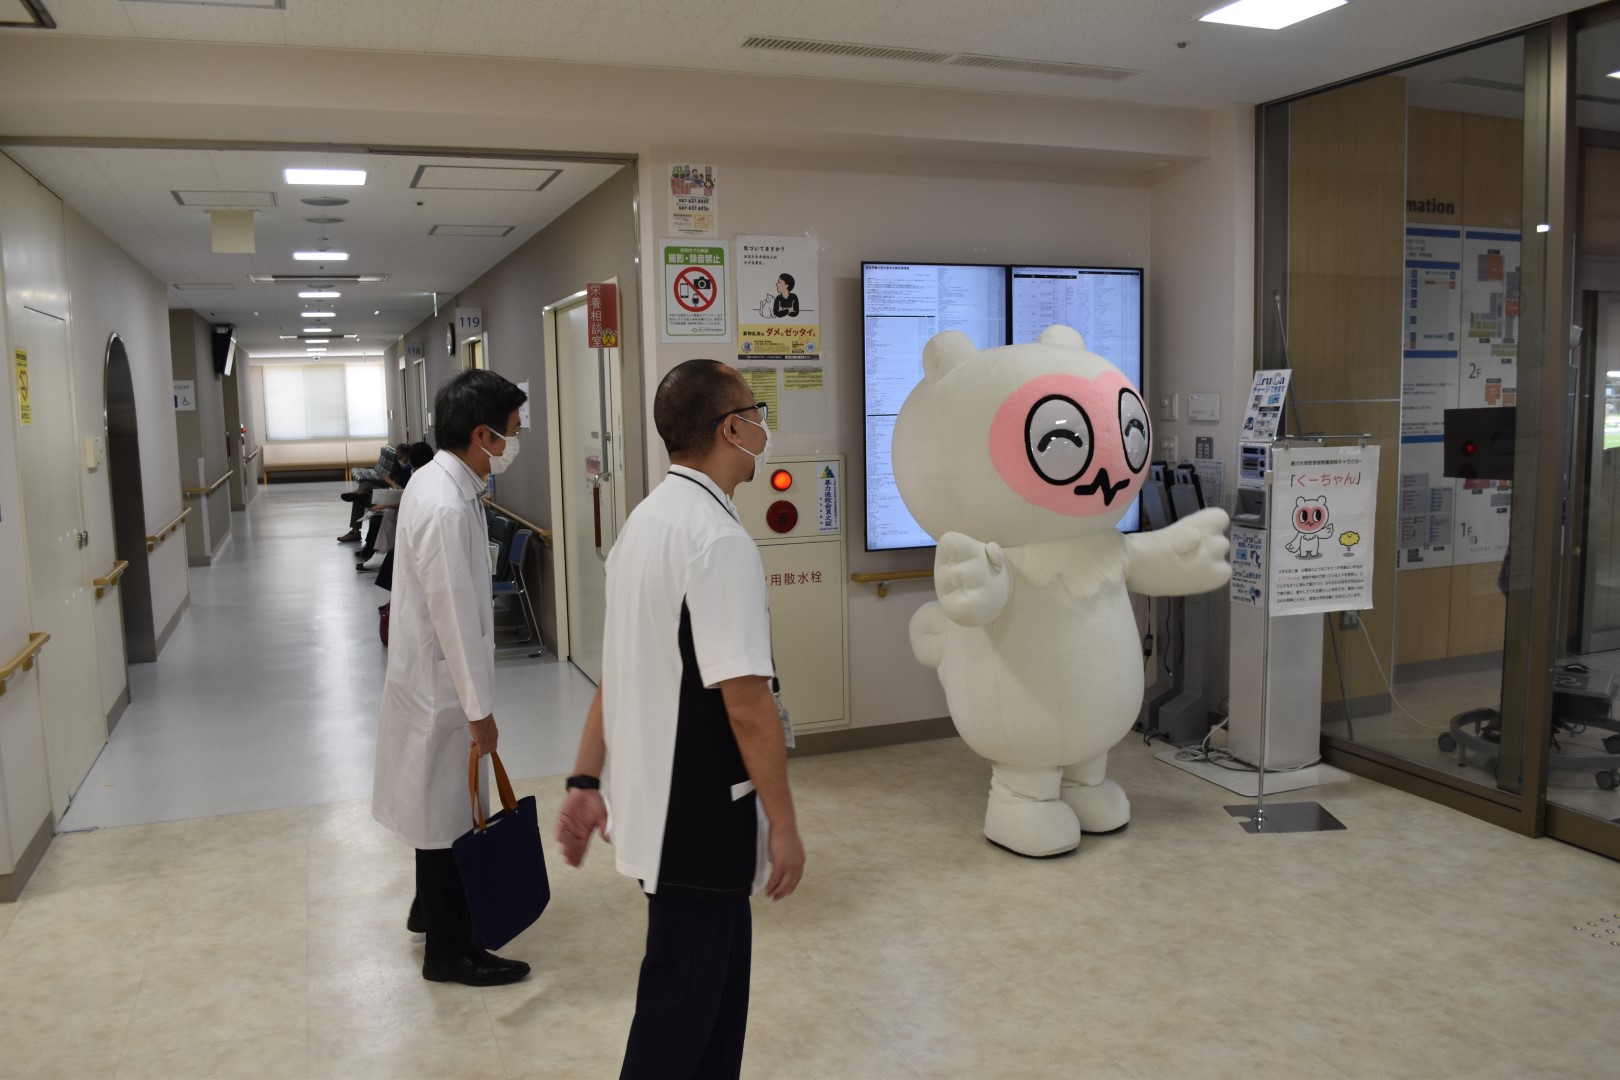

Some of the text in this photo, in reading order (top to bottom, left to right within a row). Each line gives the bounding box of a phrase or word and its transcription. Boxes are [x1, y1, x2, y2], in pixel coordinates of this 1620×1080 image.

[1406, 199, 1455, 215] mation
[668, 253, 721, 264] 撮影・録音禁止
[459, 316, 480, 328] 119
[591, 283, 603, 347] 栄養相談室
[407, 347, 421, 355] 118
[1469, 363, 1481, 379] 2F
[1256, 372, 1286, 386] IruCa
[1290, 472, 1361, 487] 「くーちゃん」
[1461, 522, 1473, 537] 1F
[765, 570, 823, 587] 用散水栓
